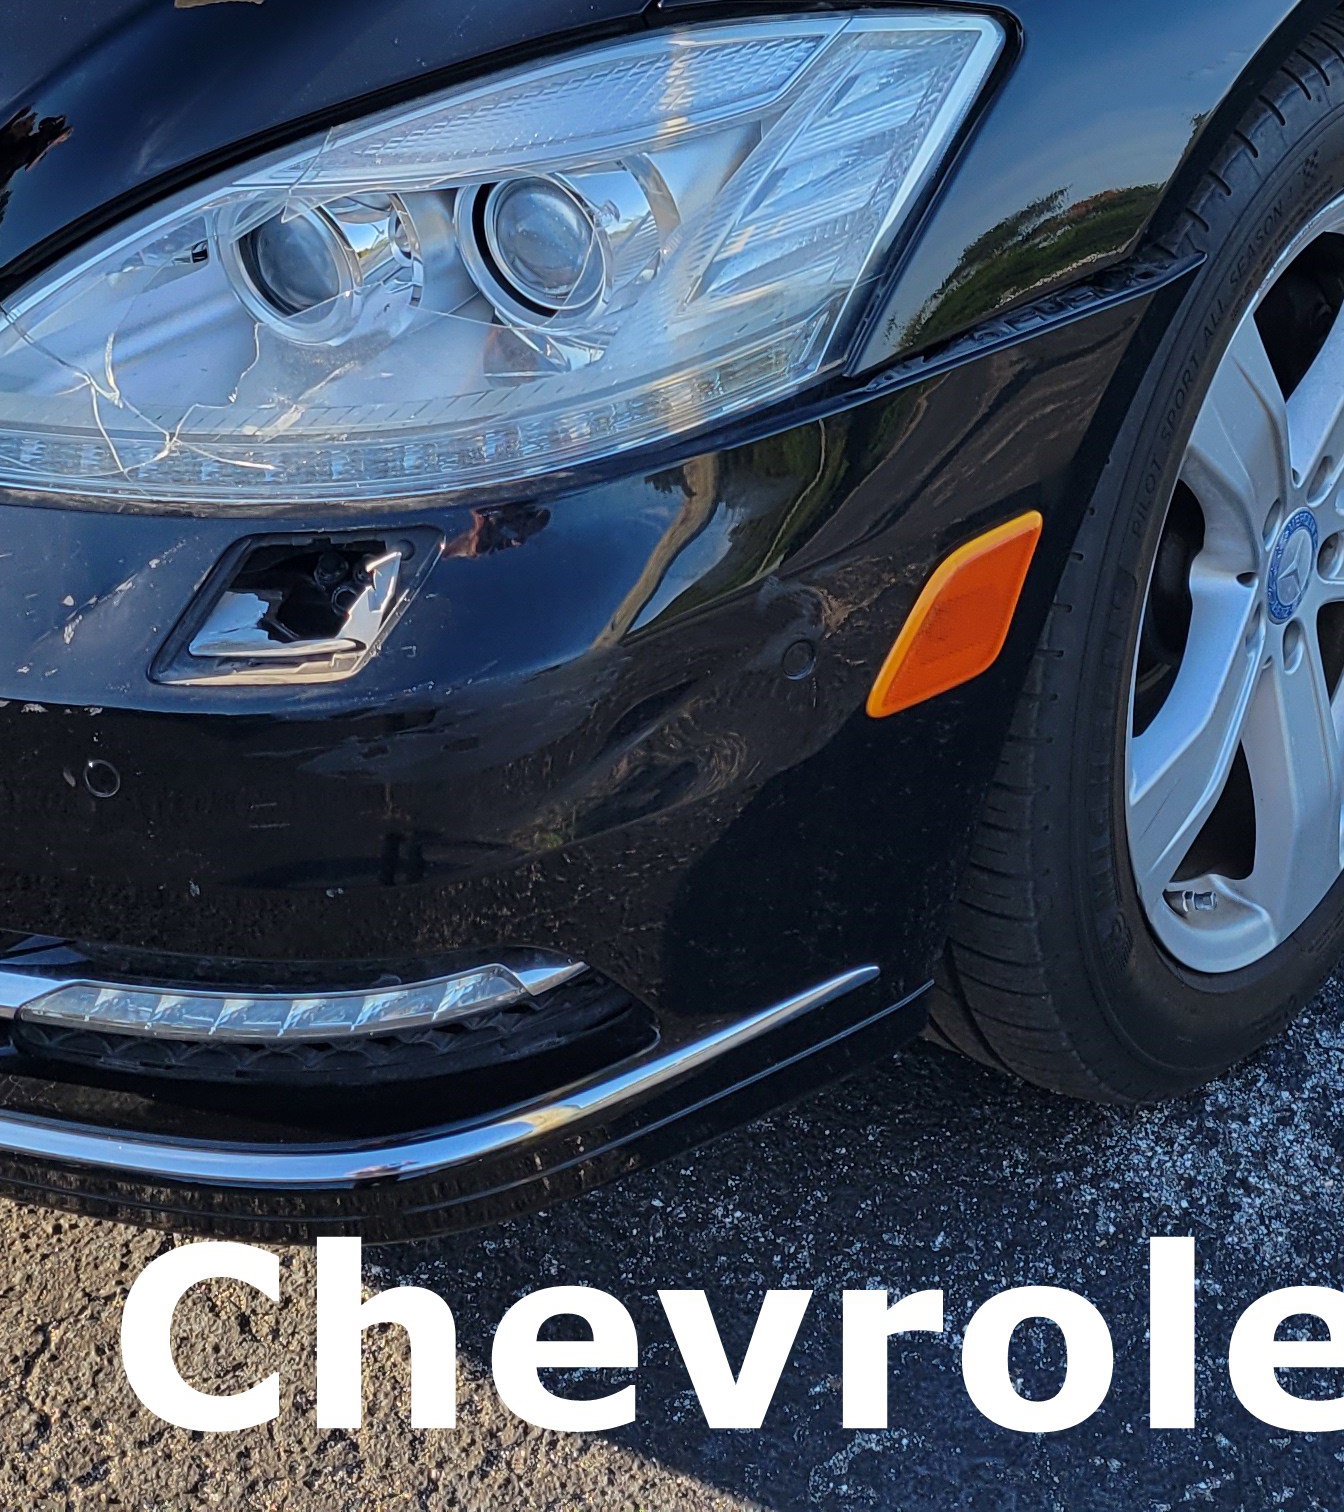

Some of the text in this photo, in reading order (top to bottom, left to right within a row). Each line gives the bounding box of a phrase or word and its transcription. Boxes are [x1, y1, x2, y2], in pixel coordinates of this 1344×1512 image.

[1132, 458, 1163, 538] PILOT
[1160, 352, 1200, 439] SPORT
[1203, 299, 1227, 338] ALL
[1229, 200, 1282, 285] SEASON
